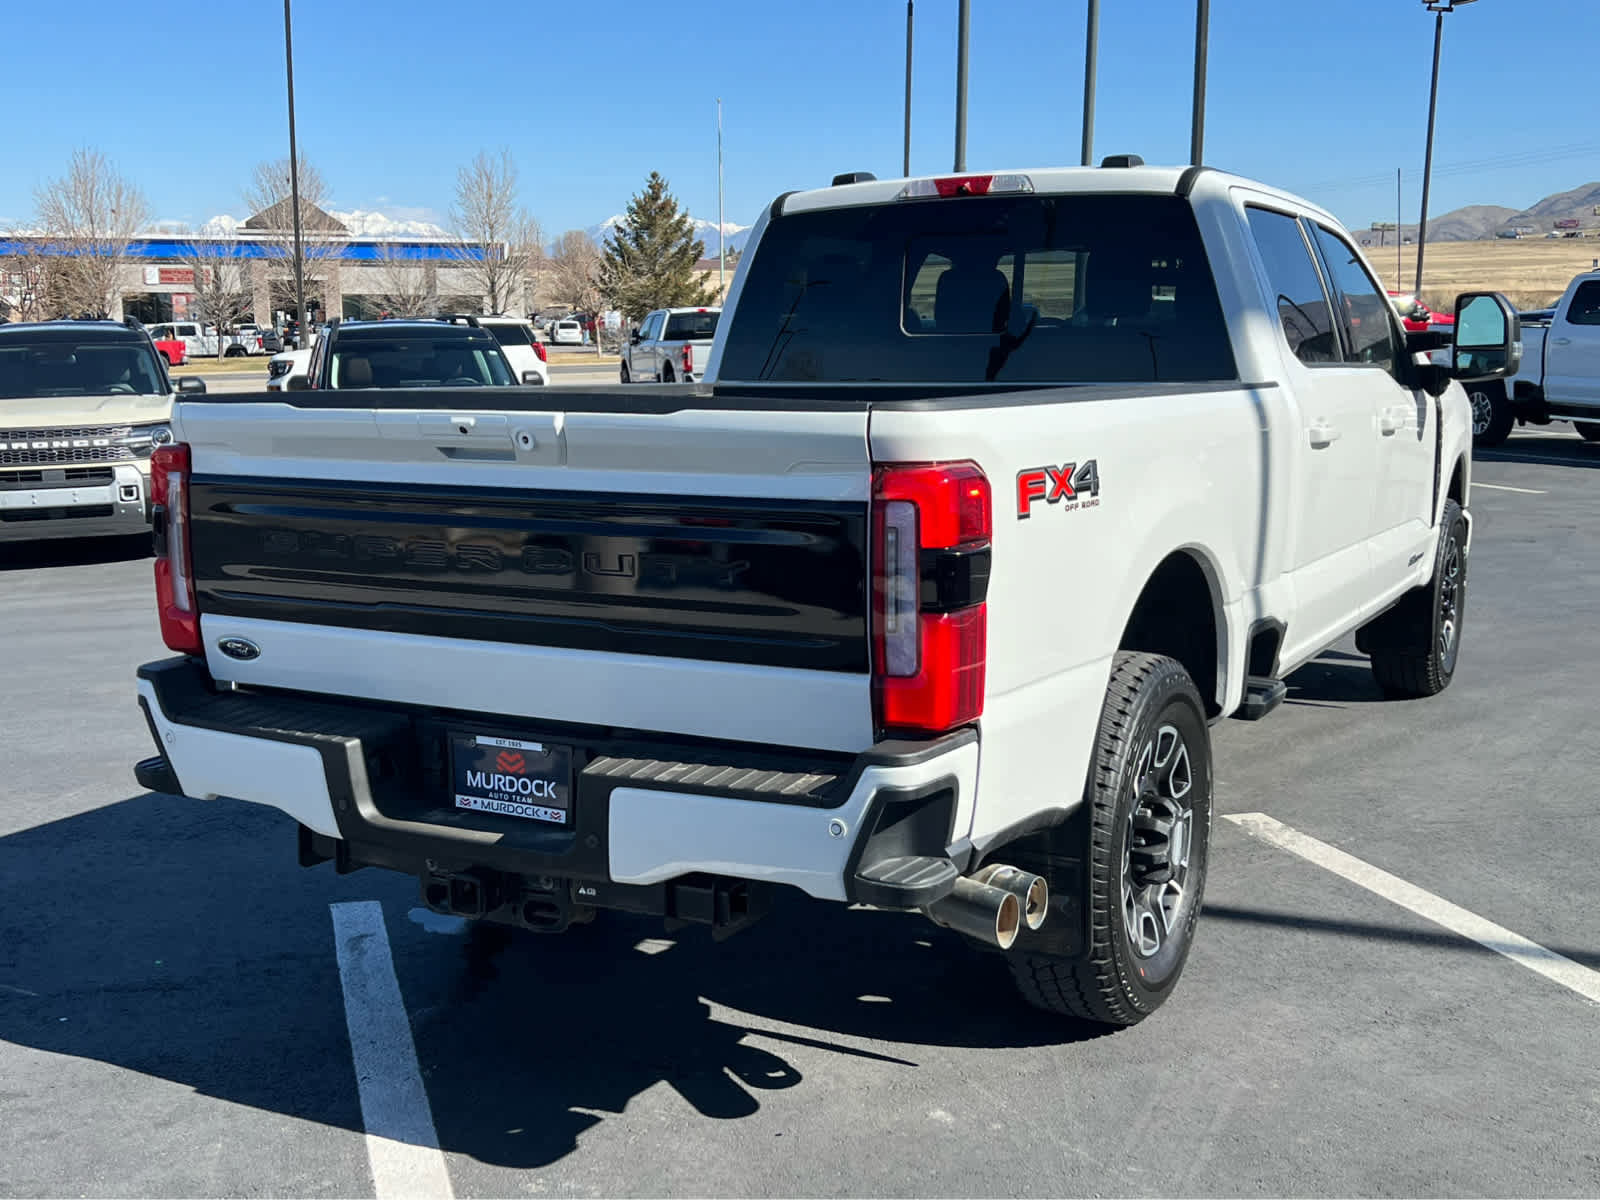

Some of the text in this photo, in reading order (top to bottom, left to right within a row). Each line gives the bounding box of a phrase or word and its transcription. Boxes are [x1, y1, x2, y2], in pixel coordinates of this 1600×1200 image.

[1016, 459, 1100, 520] FX4
[1064, 498, 1100, 512] OFF ROAD
[466, 770, 557, 799] MURDOCK
[488, 791, 533, 804] AUTO TEAM
[480, 800, 542, 818] MURDOCK
